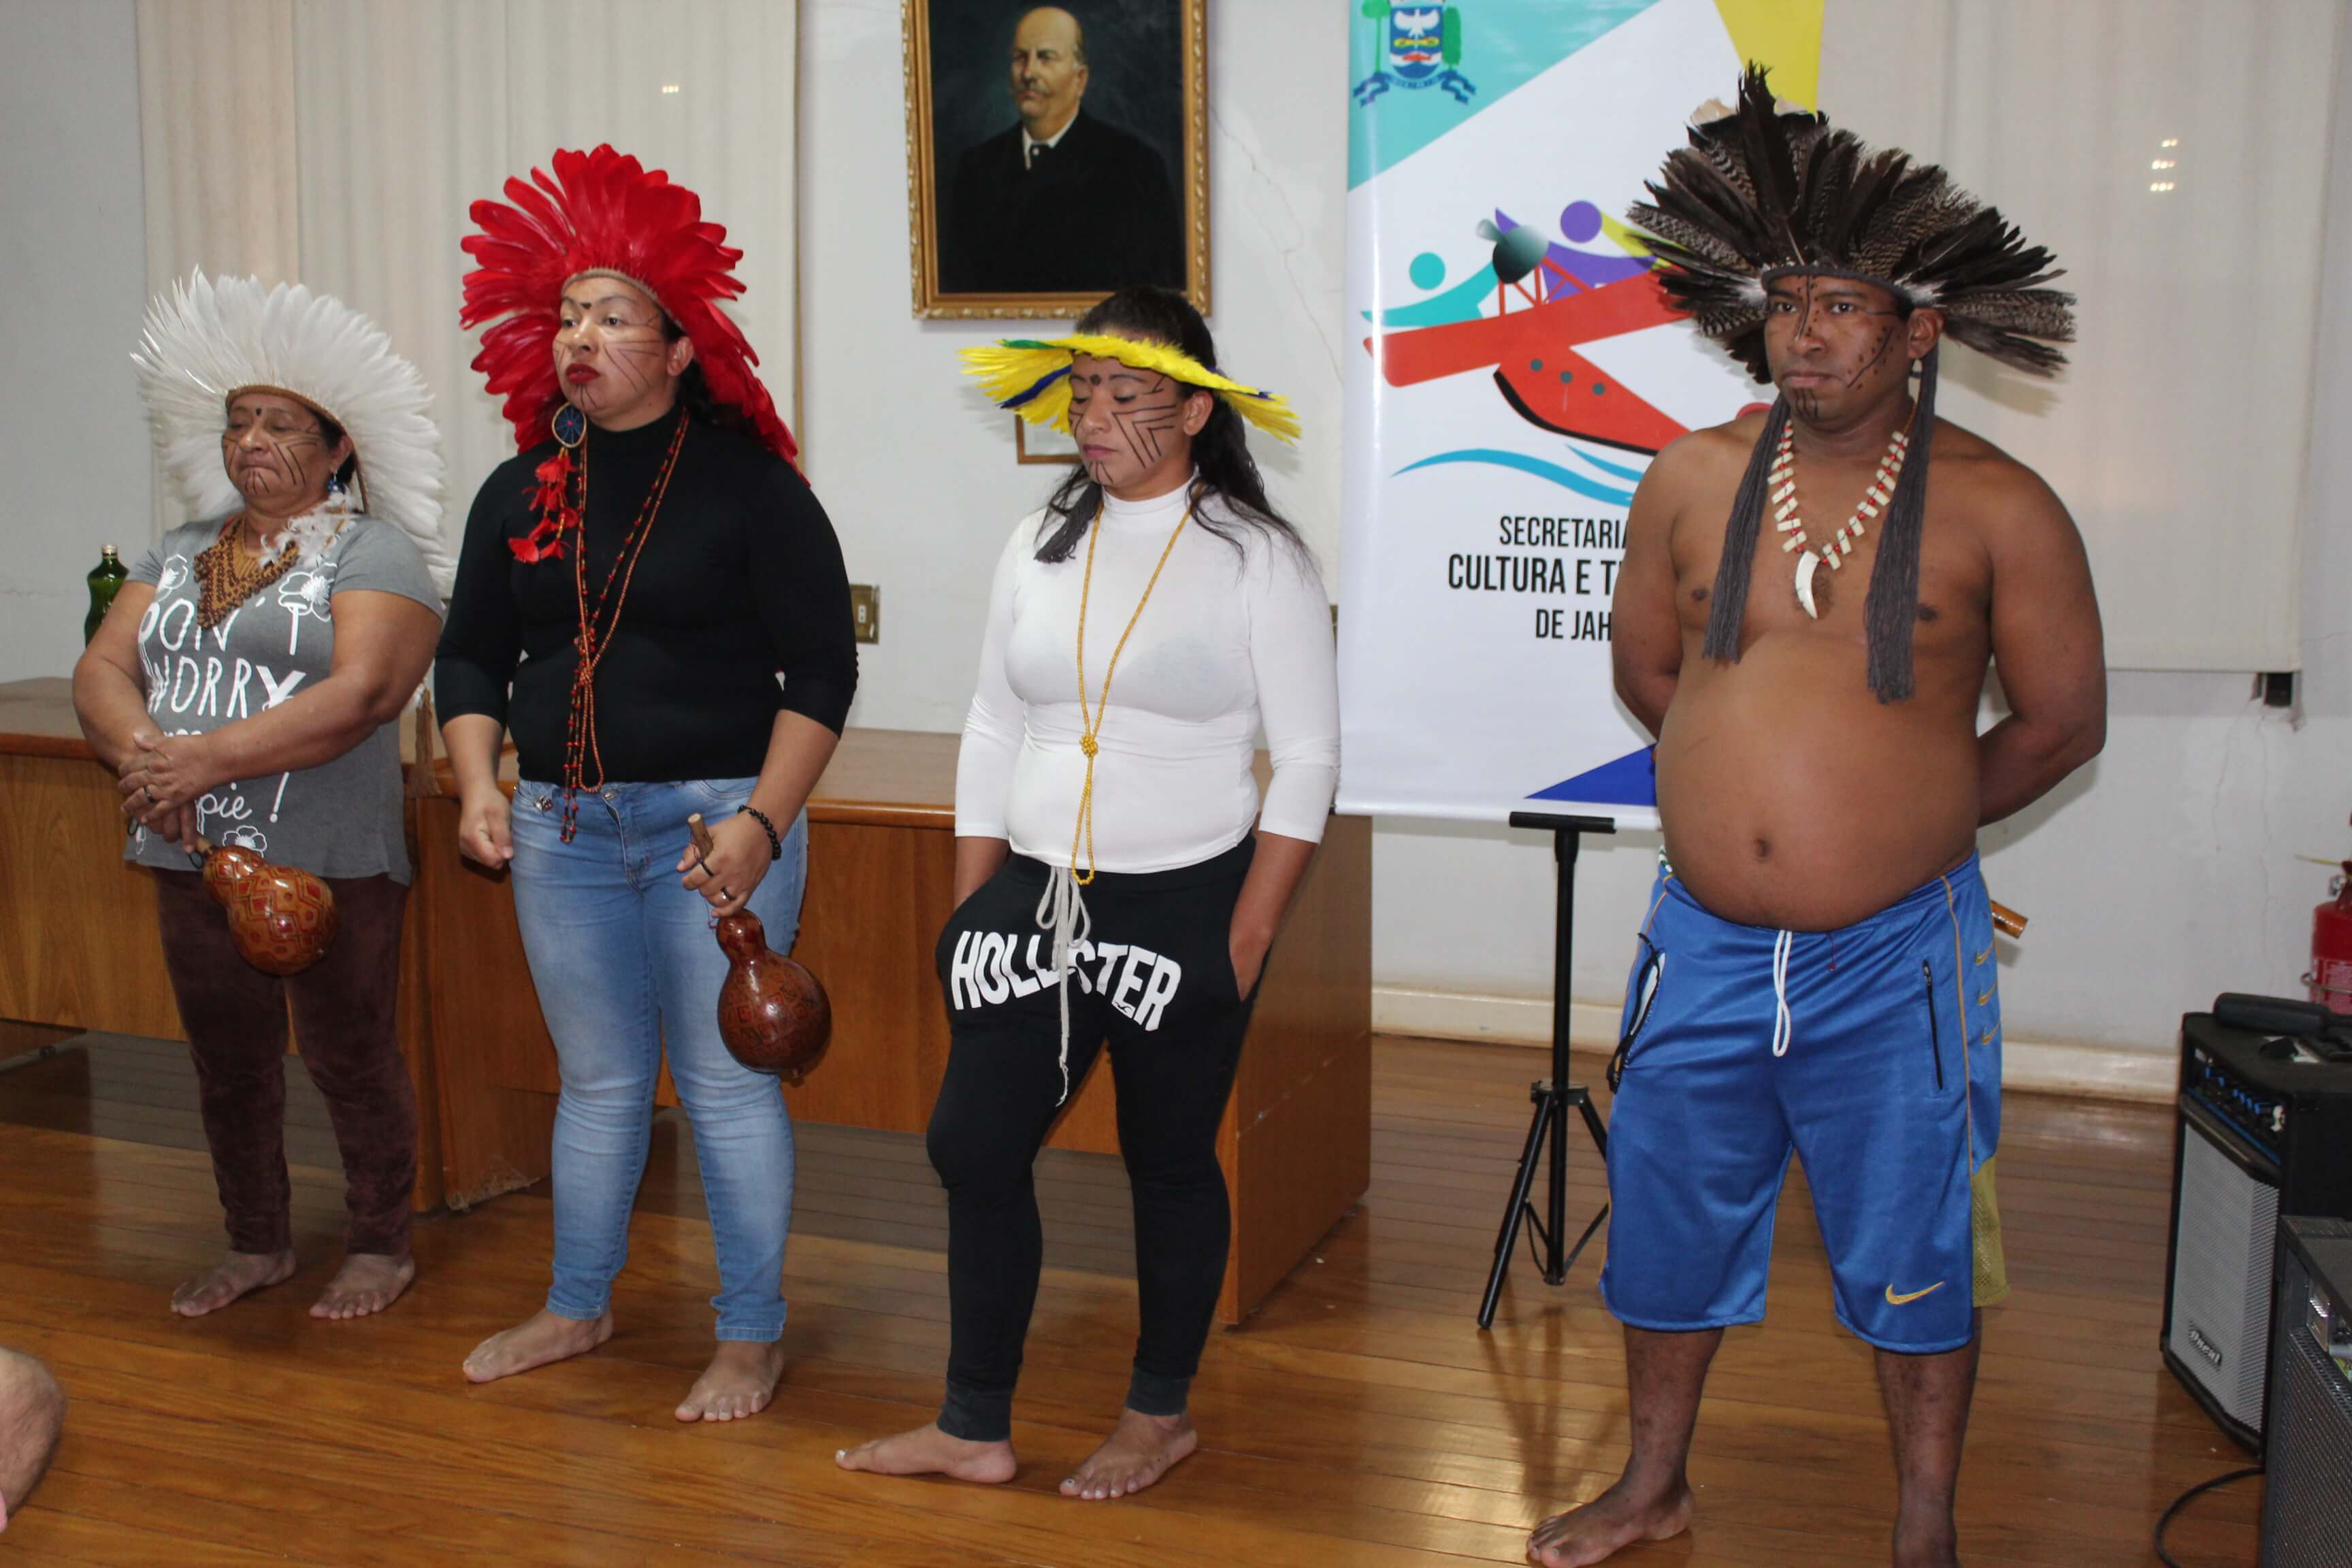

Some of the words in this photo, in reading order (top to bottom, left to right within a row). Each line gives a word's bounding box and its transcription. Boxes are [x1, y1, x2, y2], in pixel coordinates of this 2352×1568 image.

[1448, 554, 1565, 594] CULTURA
[1576, 559, 1591, 595] E
[1600, 559, 1622, 596] T
[1535, 608, 1565, 639] DE
[147, 655, 306, 719] WORRY
[951, 930, 1181, 1031] HOLLSTER
